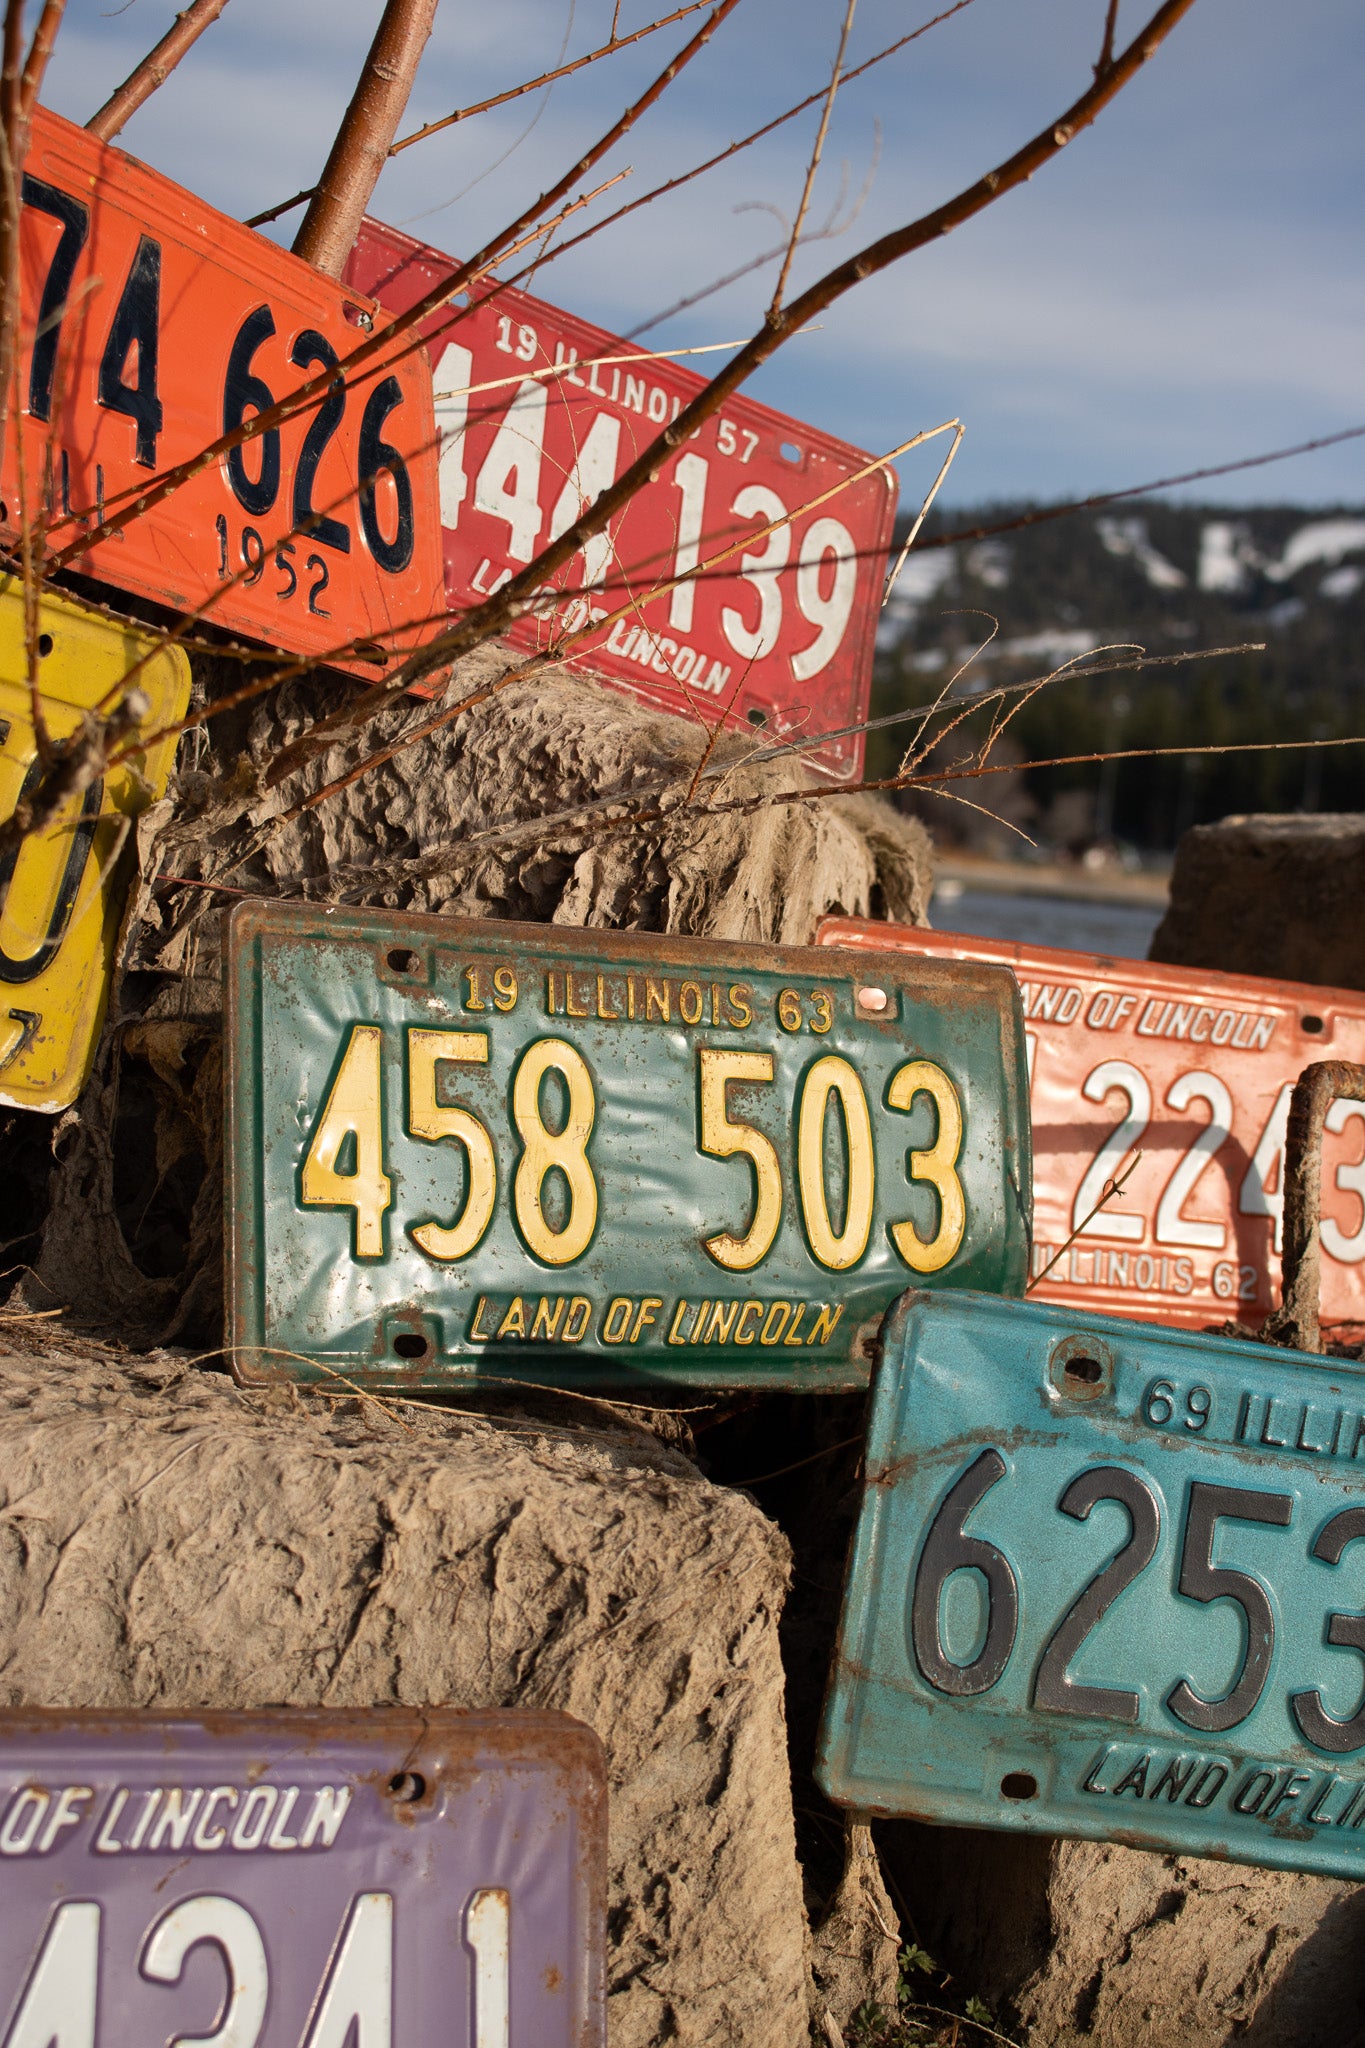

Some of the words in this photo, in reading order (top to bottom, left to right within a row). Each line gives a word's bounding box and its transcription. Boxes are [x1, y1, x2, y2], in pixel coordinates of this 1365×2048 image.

[495, 316, 538, 362] 19
[717, 418, 760, 464] 57
[222, 303, 414, 574] 626
[215, 513, 331, 618] 1952
[677, 452, 858, 681] 139
[606, 618, 732, 696] LINCOLN
[465, 966, 518, 1010] 19
[547, 971, 752, 1028] ILLINOIS
[778, 988, 833, 1033] 63
[1020, 982, 1084, 1024] AND
[1087, 992, 1138, 1031] OF
[1137, 1000, 1277, 1050] LINCOLN
[302, 1026, 598, 1266] 458
[700, 1049, 966, 1274] 503
[1032, 1243, 1194, 1295] ILLINOIS
[1213, 1262, 1258, 1300] 62
[470, 1297, 592, 1342] LAND
[602, 1298, 663, 1343] OF
[669, 1299, 844, 1345] LINCOLN
[1147, 1378, 1212, 1432] 69
[1083, 1748, 1229, 1808] LAND
[1234, 1769, 1311, 1817] OF
[0, 1787, 93, 1852] OF
[96, 1785, 352, 1850] LINCOLN
